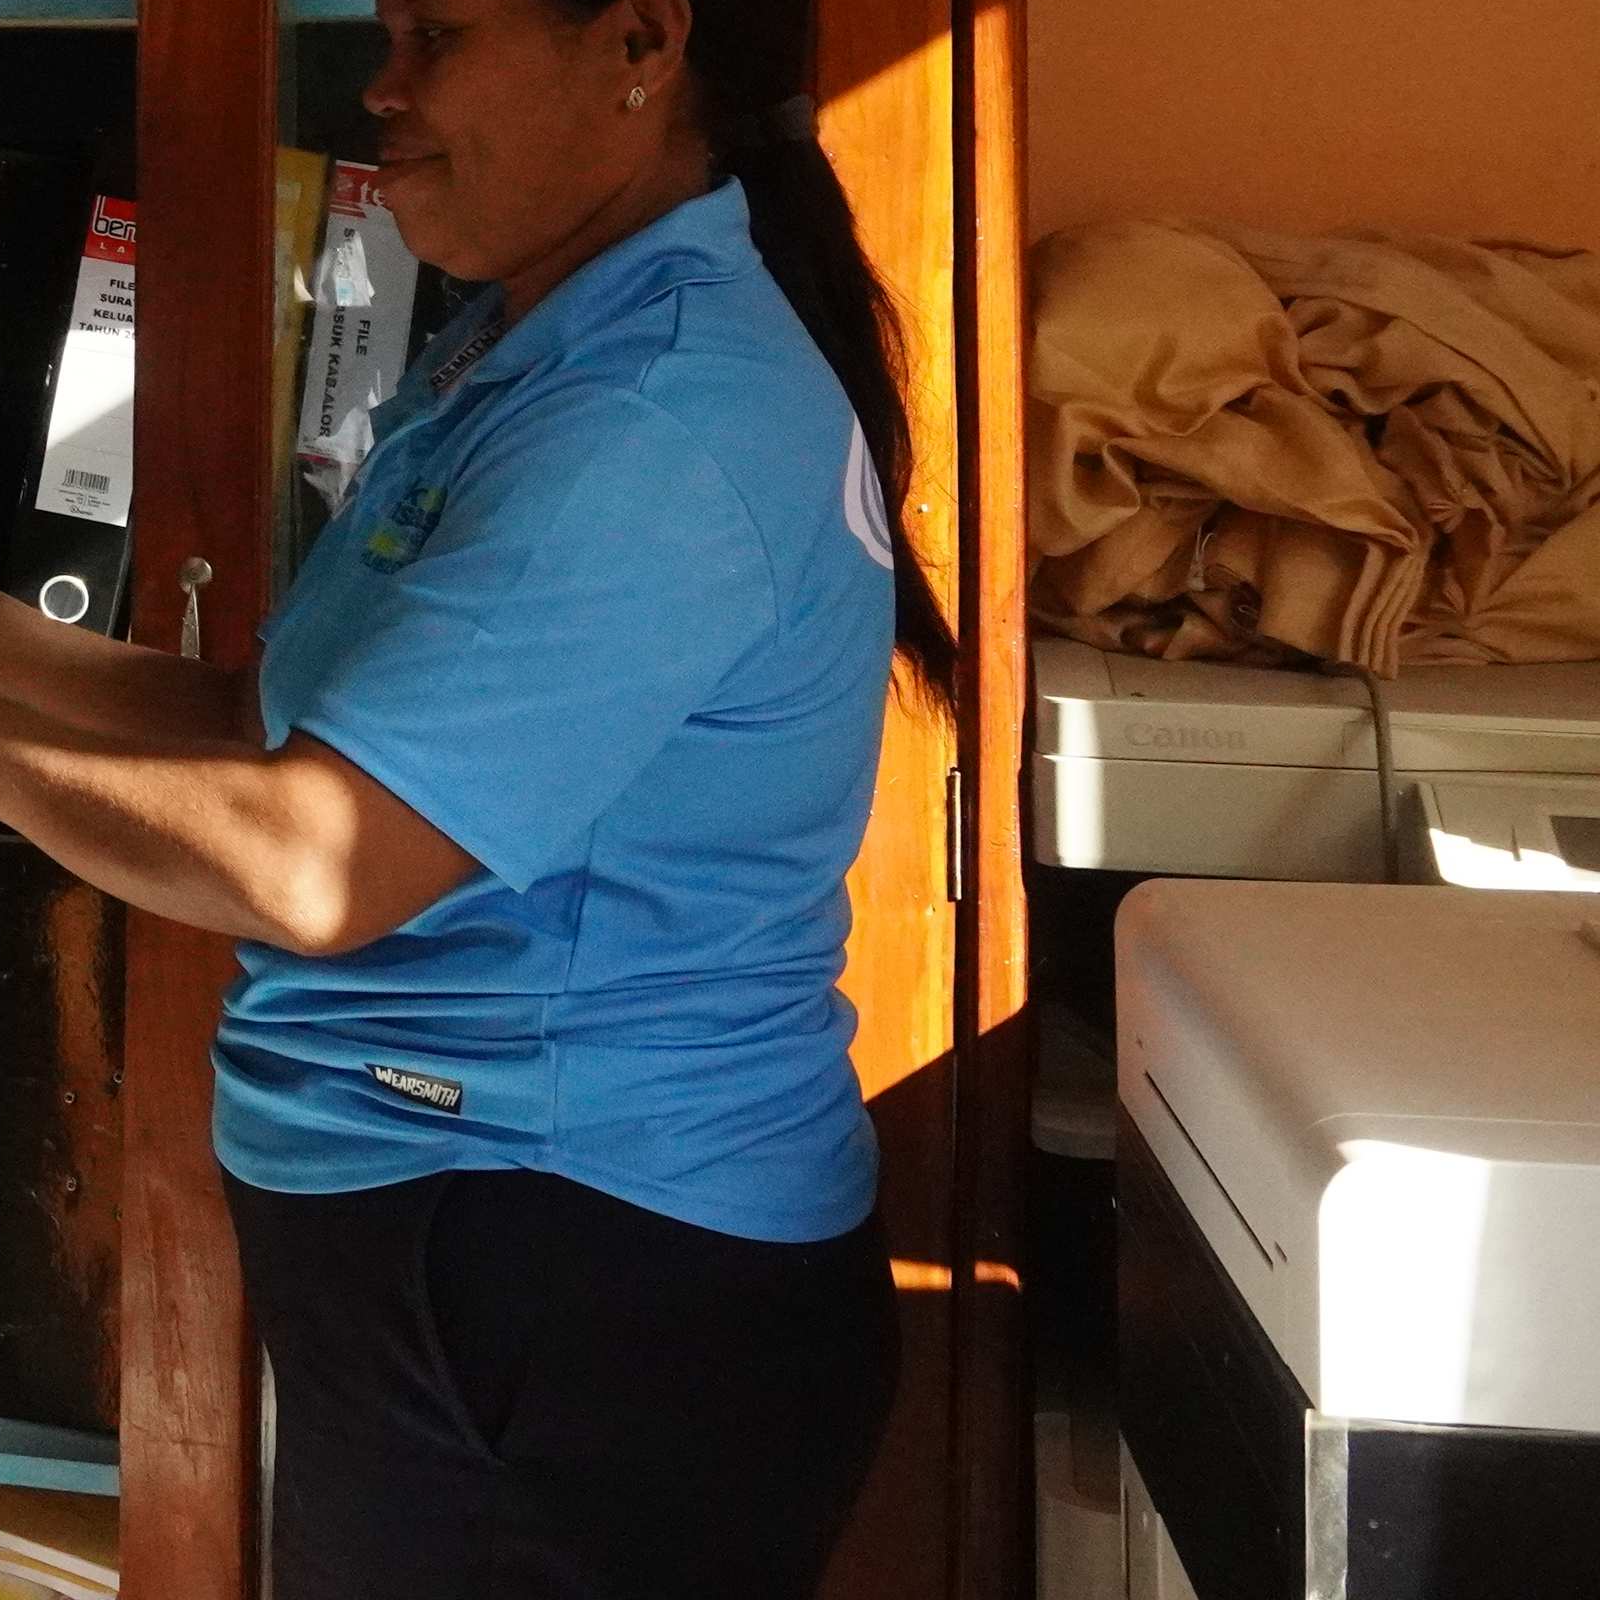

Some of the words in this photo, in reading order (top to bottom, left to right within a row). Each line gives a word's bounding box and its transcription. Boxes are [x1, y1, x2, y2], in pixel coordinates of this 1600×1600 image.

[110, 278, 136, 291] FILE
[100, 293, 136, 307] SURA
[93, 308, 134, 323] KELUA
[79, 322, 120, 337] TAHUN
[356, 319, 371, 356] FILE
[1123, 722, 1246, 749] Canon
[374, 1066, 461, 1107] WEARSMITH
